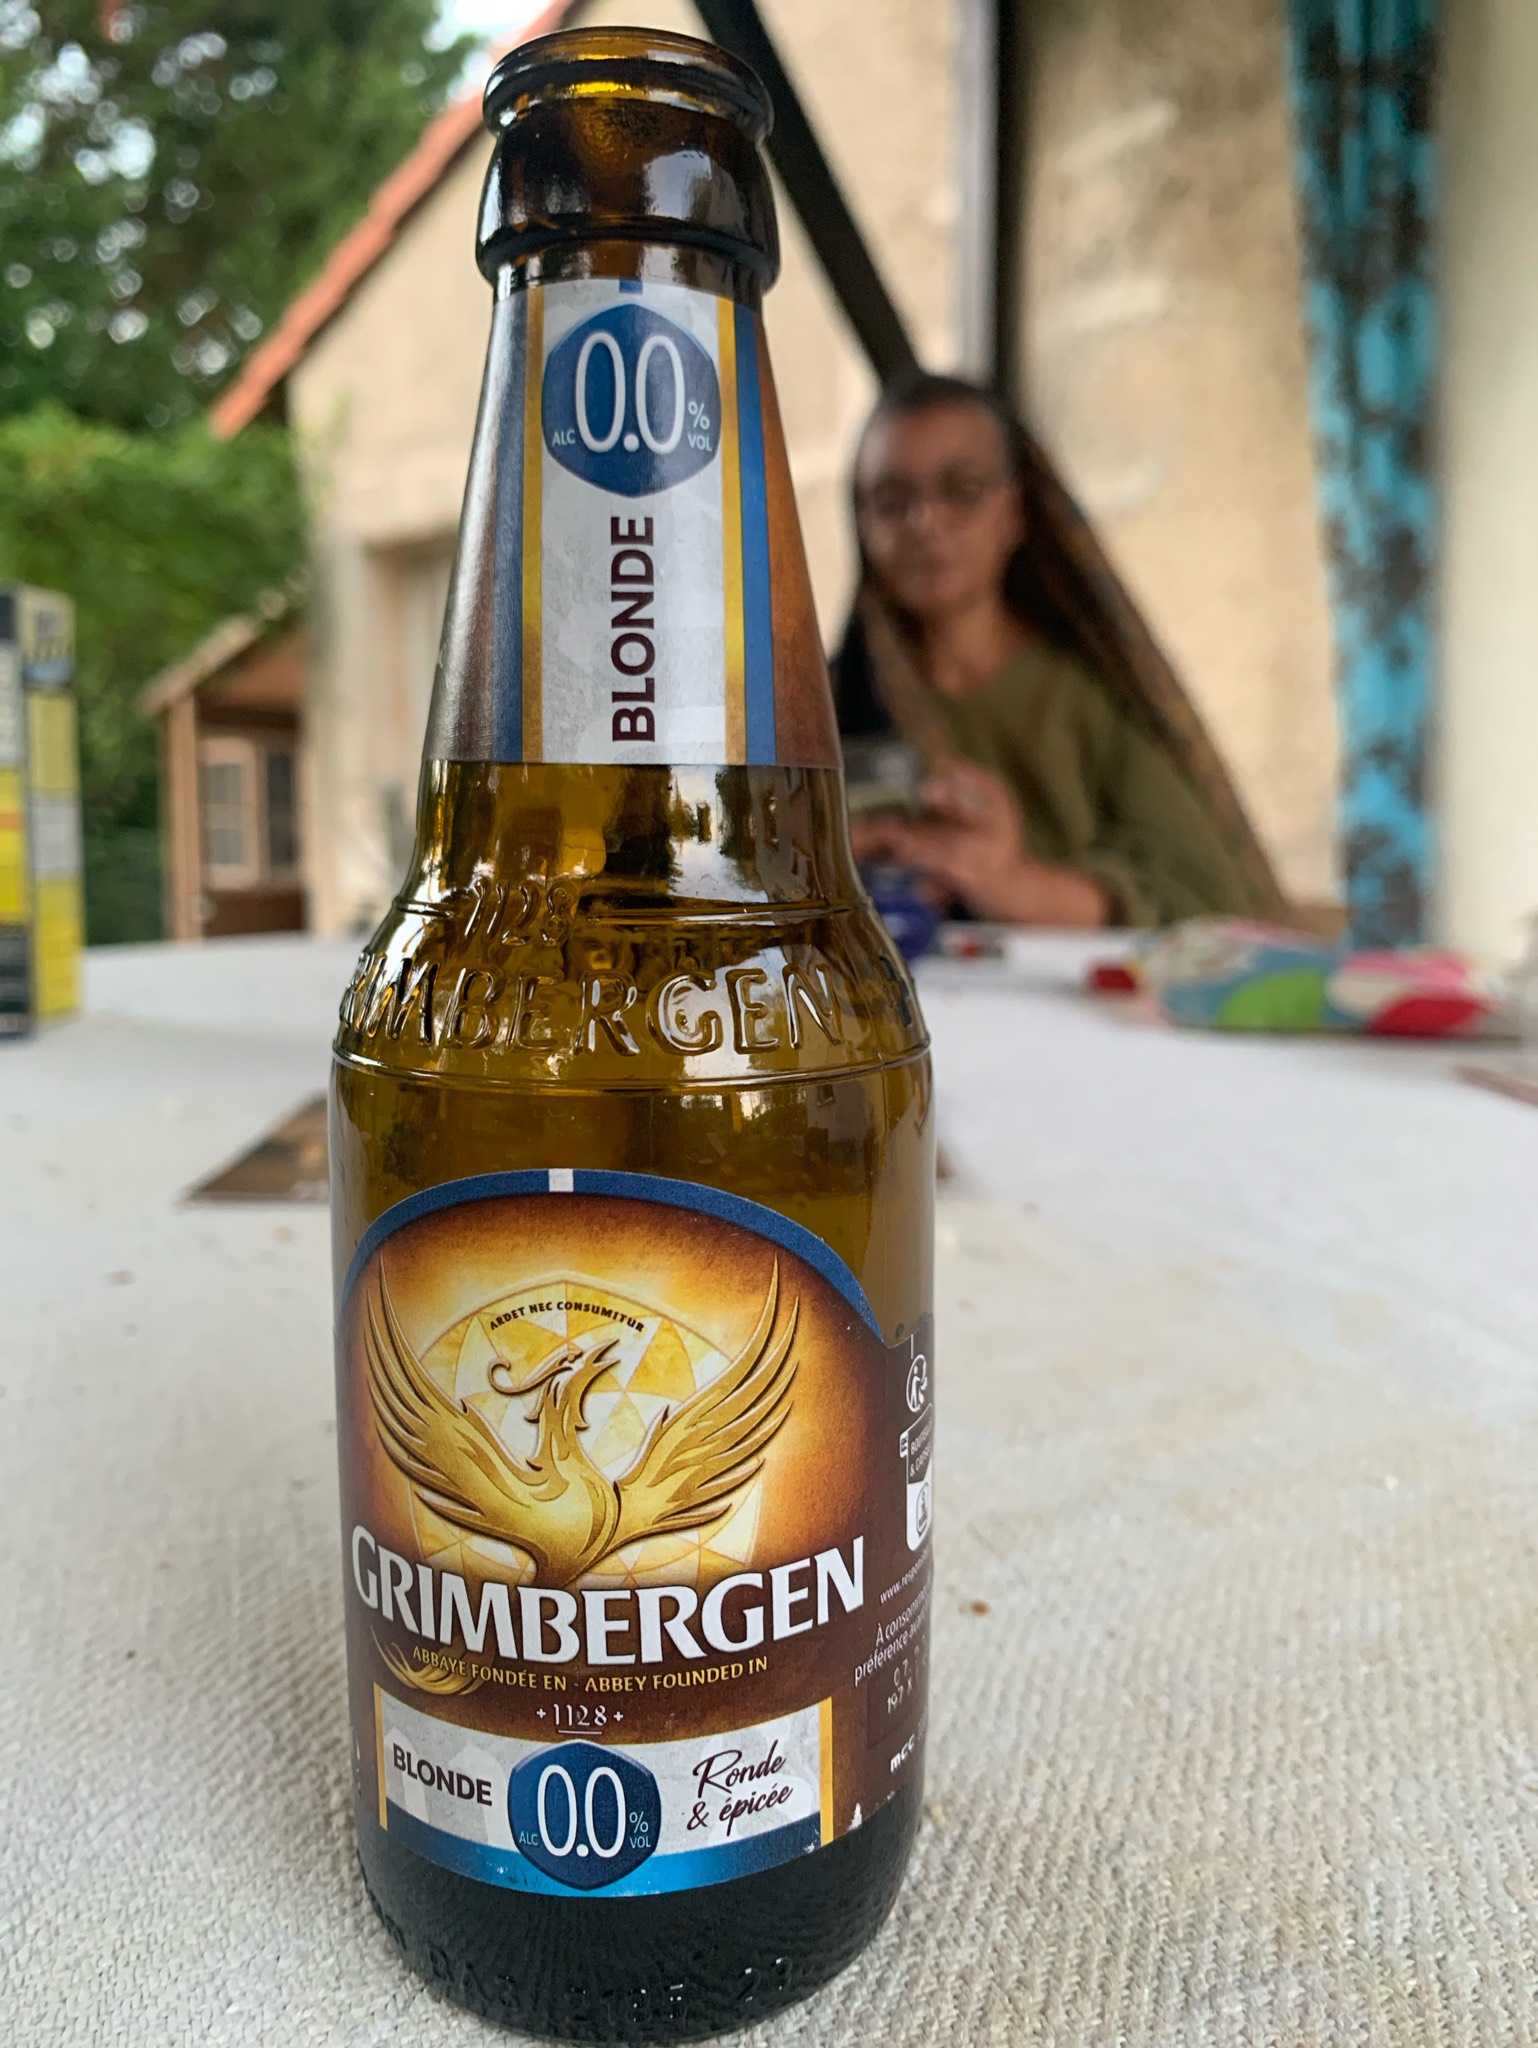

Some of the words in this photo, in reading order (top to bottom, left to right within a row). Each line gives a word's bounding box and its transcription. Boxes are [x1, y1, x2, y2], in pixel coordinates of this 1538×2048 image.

[575, 331, 684, 453] 0.0
[688, 401, 710, 431] %
[551, 428, 576, 447] ALC
[687, 432, 713, 452] VOL
[611, 515, 656, 742] BLONDE
[490, 1306, 525, 1331] ARDET
[529, 1301, 553, 1314] NEC
[556, 1301, 645, 1333] CONSUMITUR
[351, 1525, 865, 1666] GRIMBERGEN
[854, 1630, 909, 1687] préférence
[875, 1622, 884, 1647] À
[412, 1645, 468, 1677] ABBAYE
[471, 1663, 537, 1689] FONDÉE
[543, 1674, 567, 1692] EN
[585, 1675, 647, 1693] ABBEY
[652, 1662, 743, 1690] FOUNDED
[748, 1656, 768, 1675] IN
[553, 1703, 607, 1727] 1128
[392, 1743, 493, 1807] BLONDE
[692, 1739, 786, 1799] Ronde
[537, 1764, 626, 1859] 0.0
[629, 1811, 649, 1834] %
[686, 1801, 709, 1831] &
[719, 1782, 794, 1837] épicée
[519, 1831, 539, 1847] ALC
[629, 1836, 652, 1849] VOL
